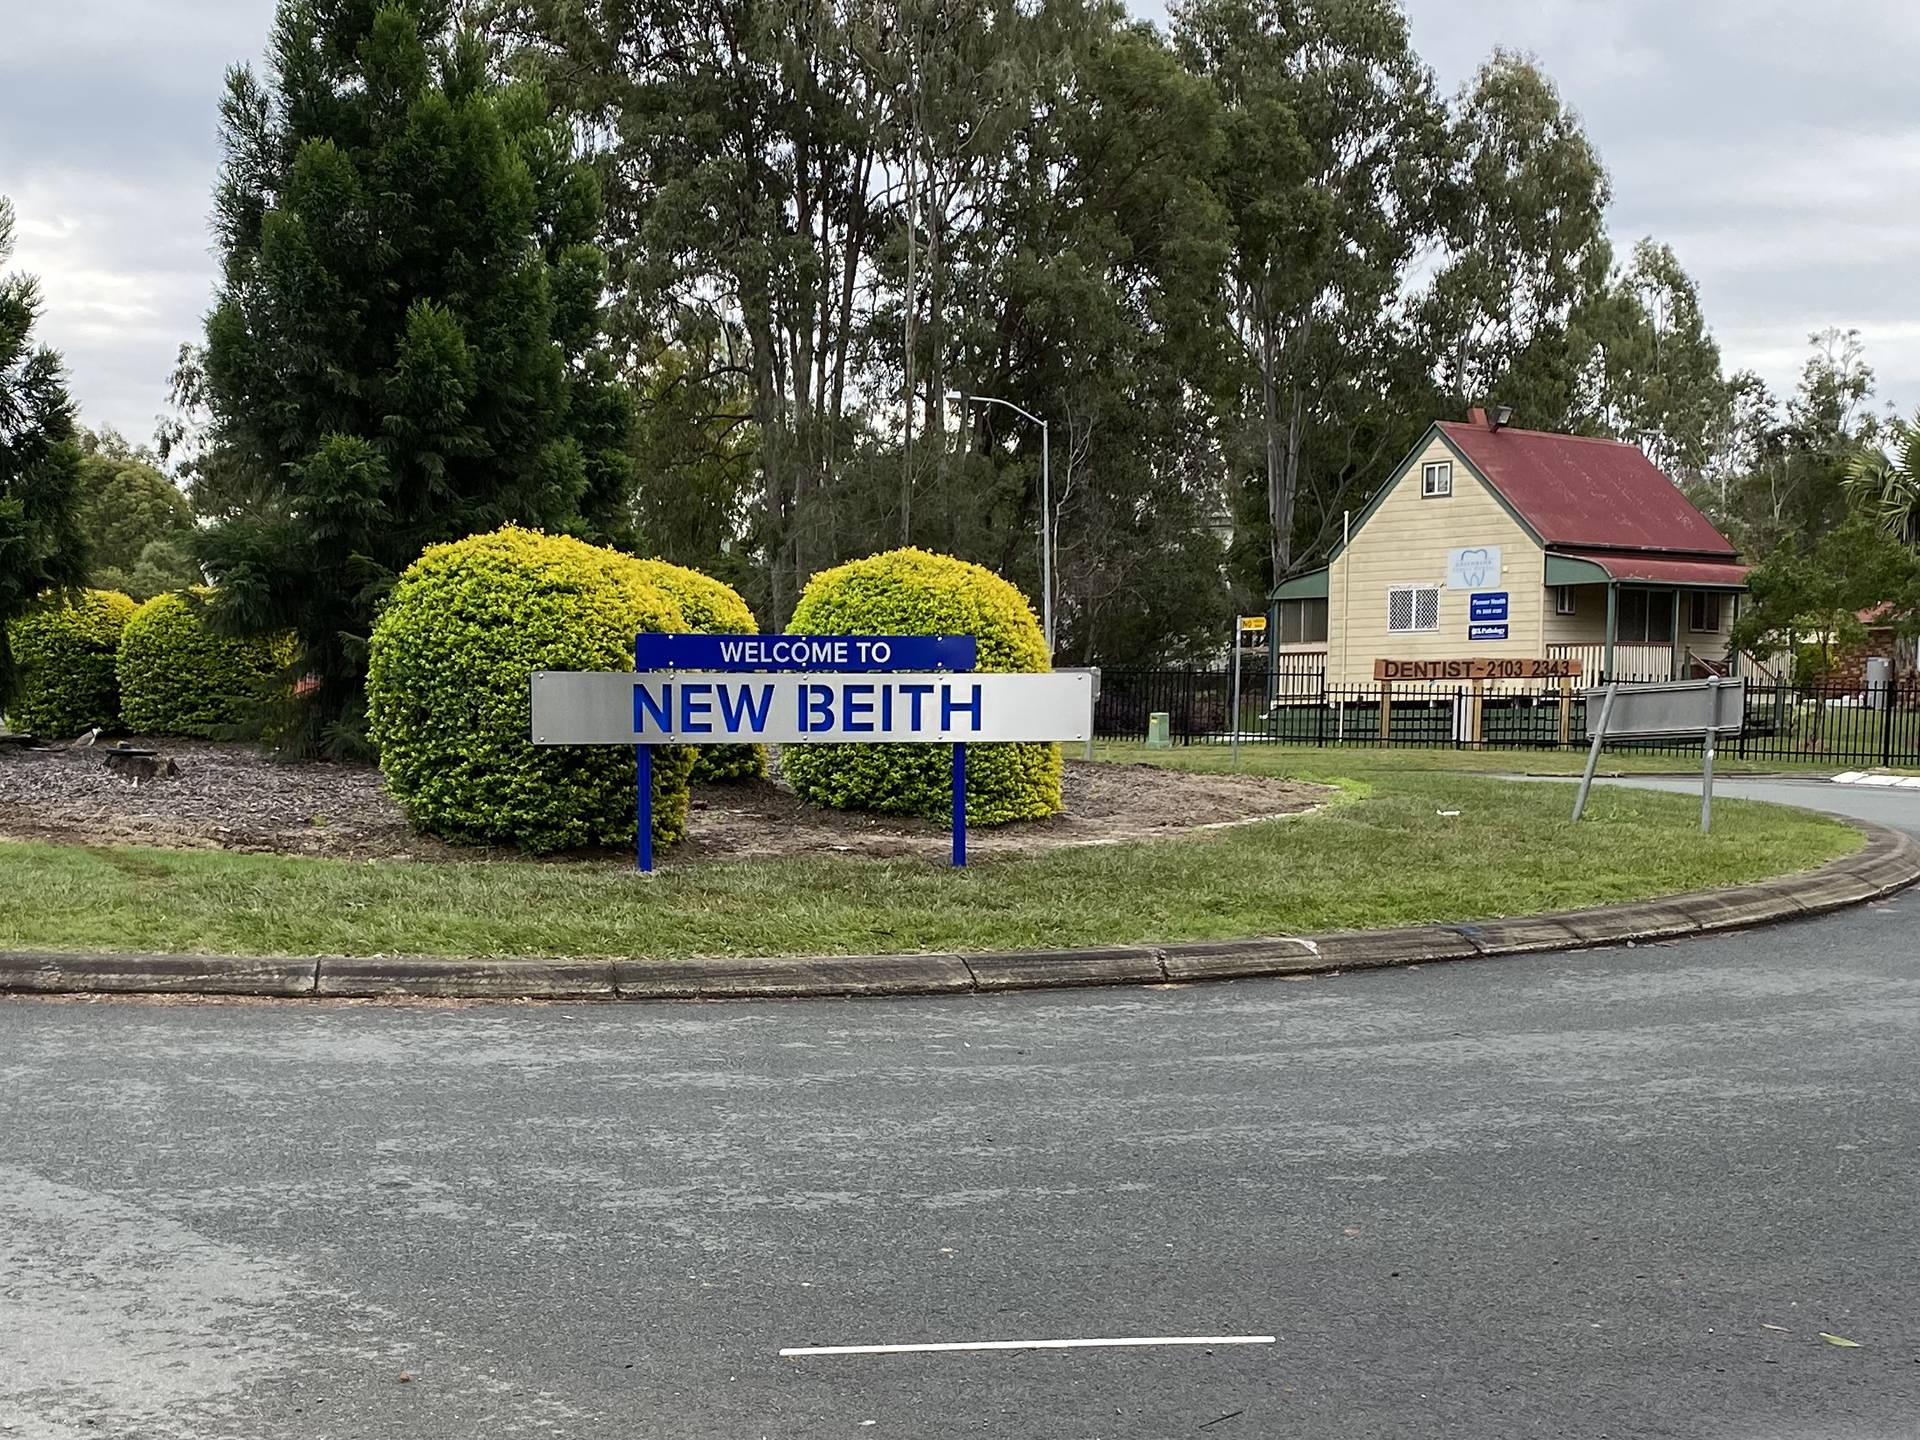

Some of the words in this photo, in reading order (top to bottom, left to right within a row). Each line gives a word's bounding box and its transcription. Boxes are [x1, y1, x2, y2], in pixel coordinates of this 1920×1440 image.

[720, 642, 848, 663] WELCOME
[856, 641, 892, 663] TO
[1384, 661, 1475, 678] DENTIST
[1487, 660, 1523, 677] 2103
[1532, 660, 1569, 676] 2343
[632, 683, 776, 734] NEW
[797, 683, 983, 733] BEITH
